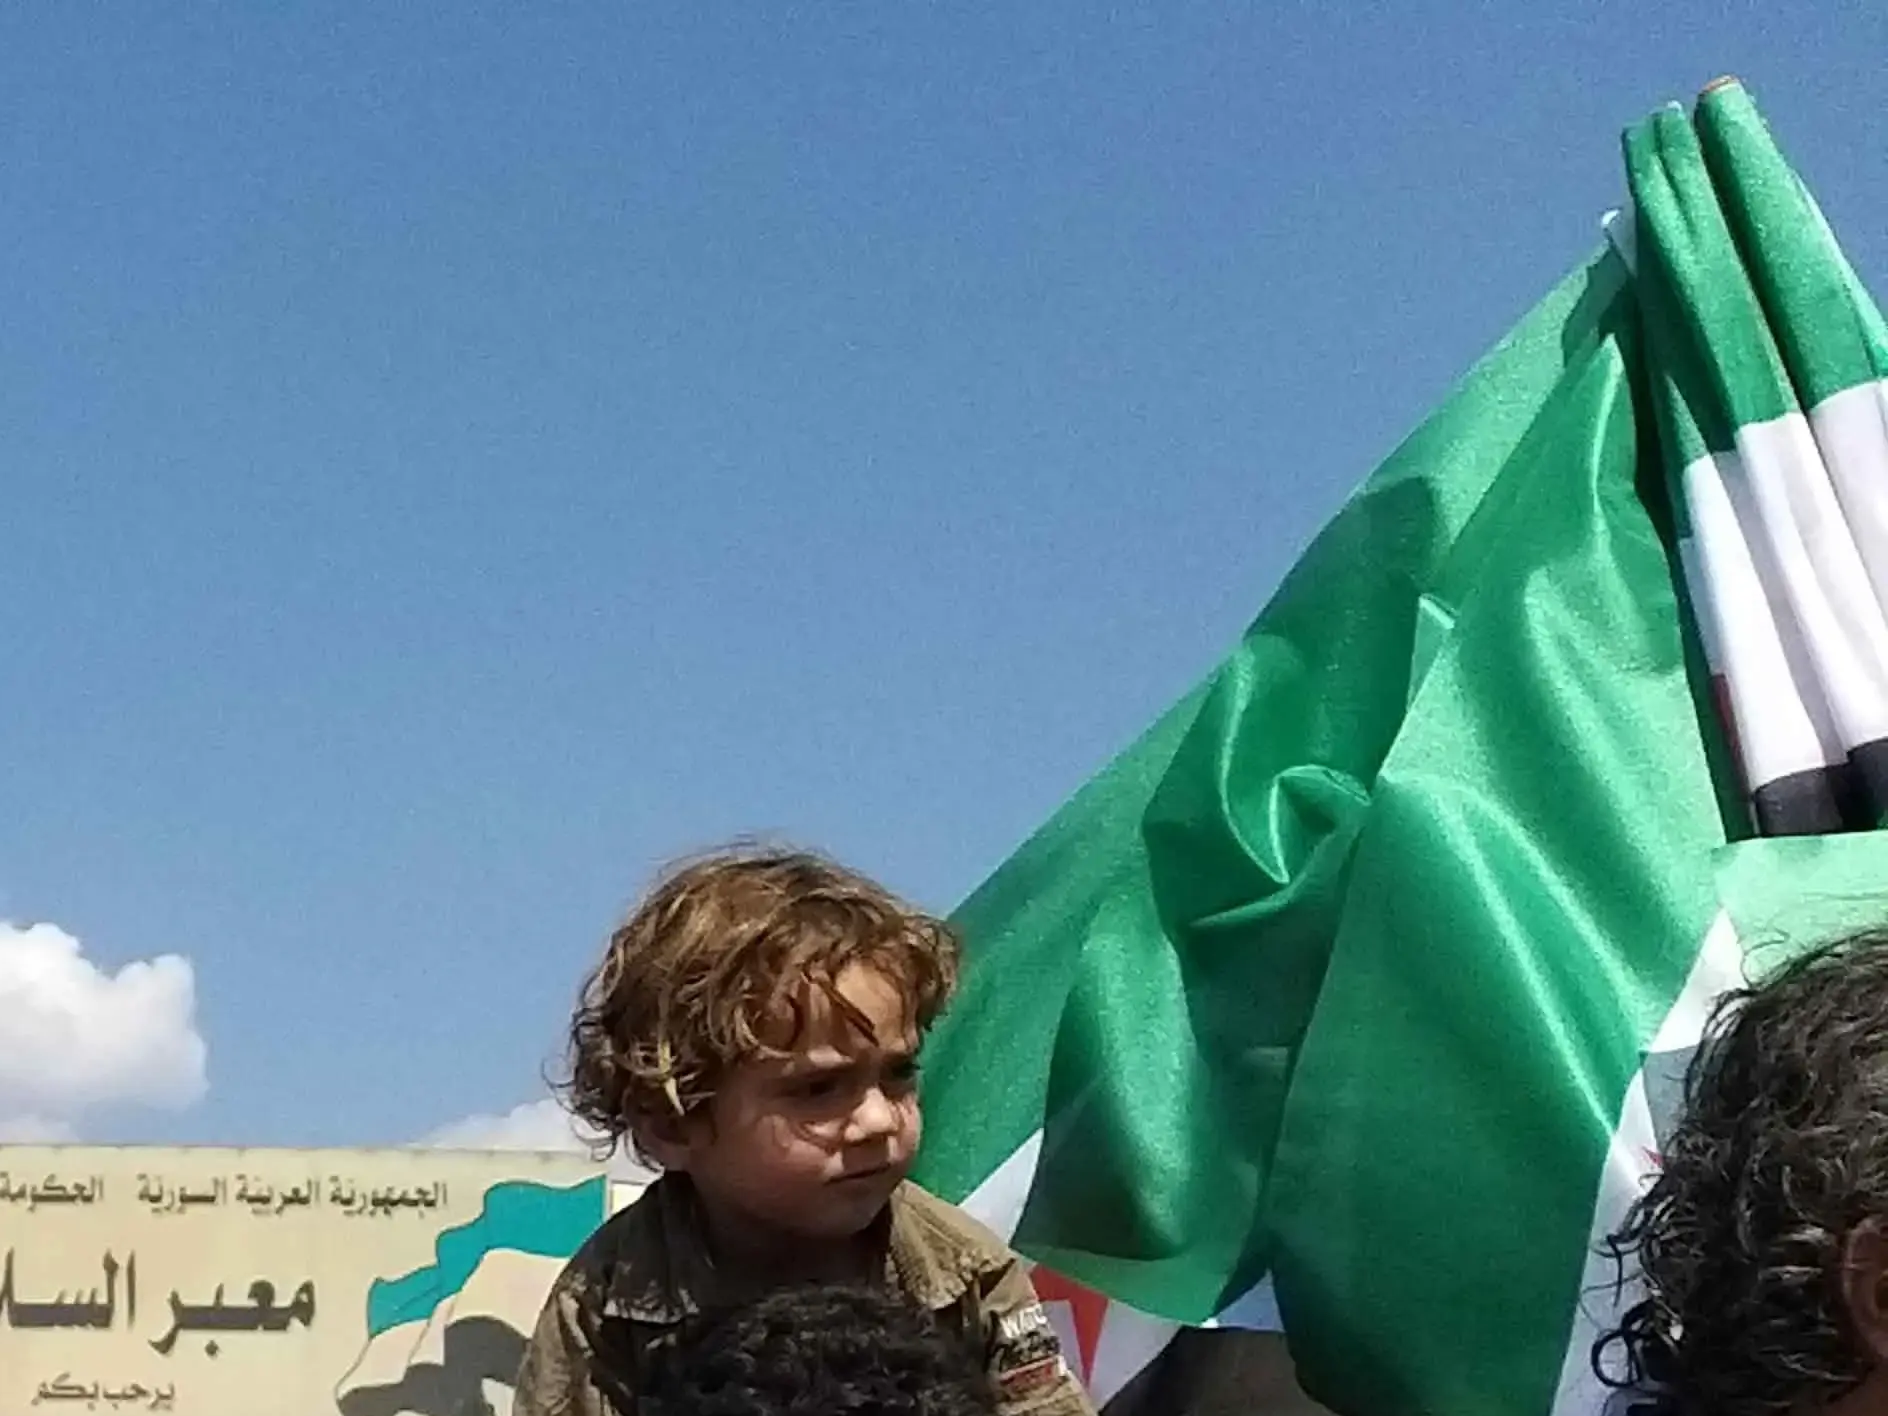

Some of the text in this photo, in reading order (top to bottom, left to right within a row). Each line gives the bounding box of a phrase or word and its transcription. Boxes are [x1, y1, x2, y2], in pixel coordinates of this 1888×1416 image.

[136, 1173, 227, 1217] السورية
[235, 1173, 321, 1219] العربية
[328, 1174, 449, 1220] الجمهورية
[147, 1278, 316, 1357] معبر
[30, 1372, 176, 1410] يرحب بكم
